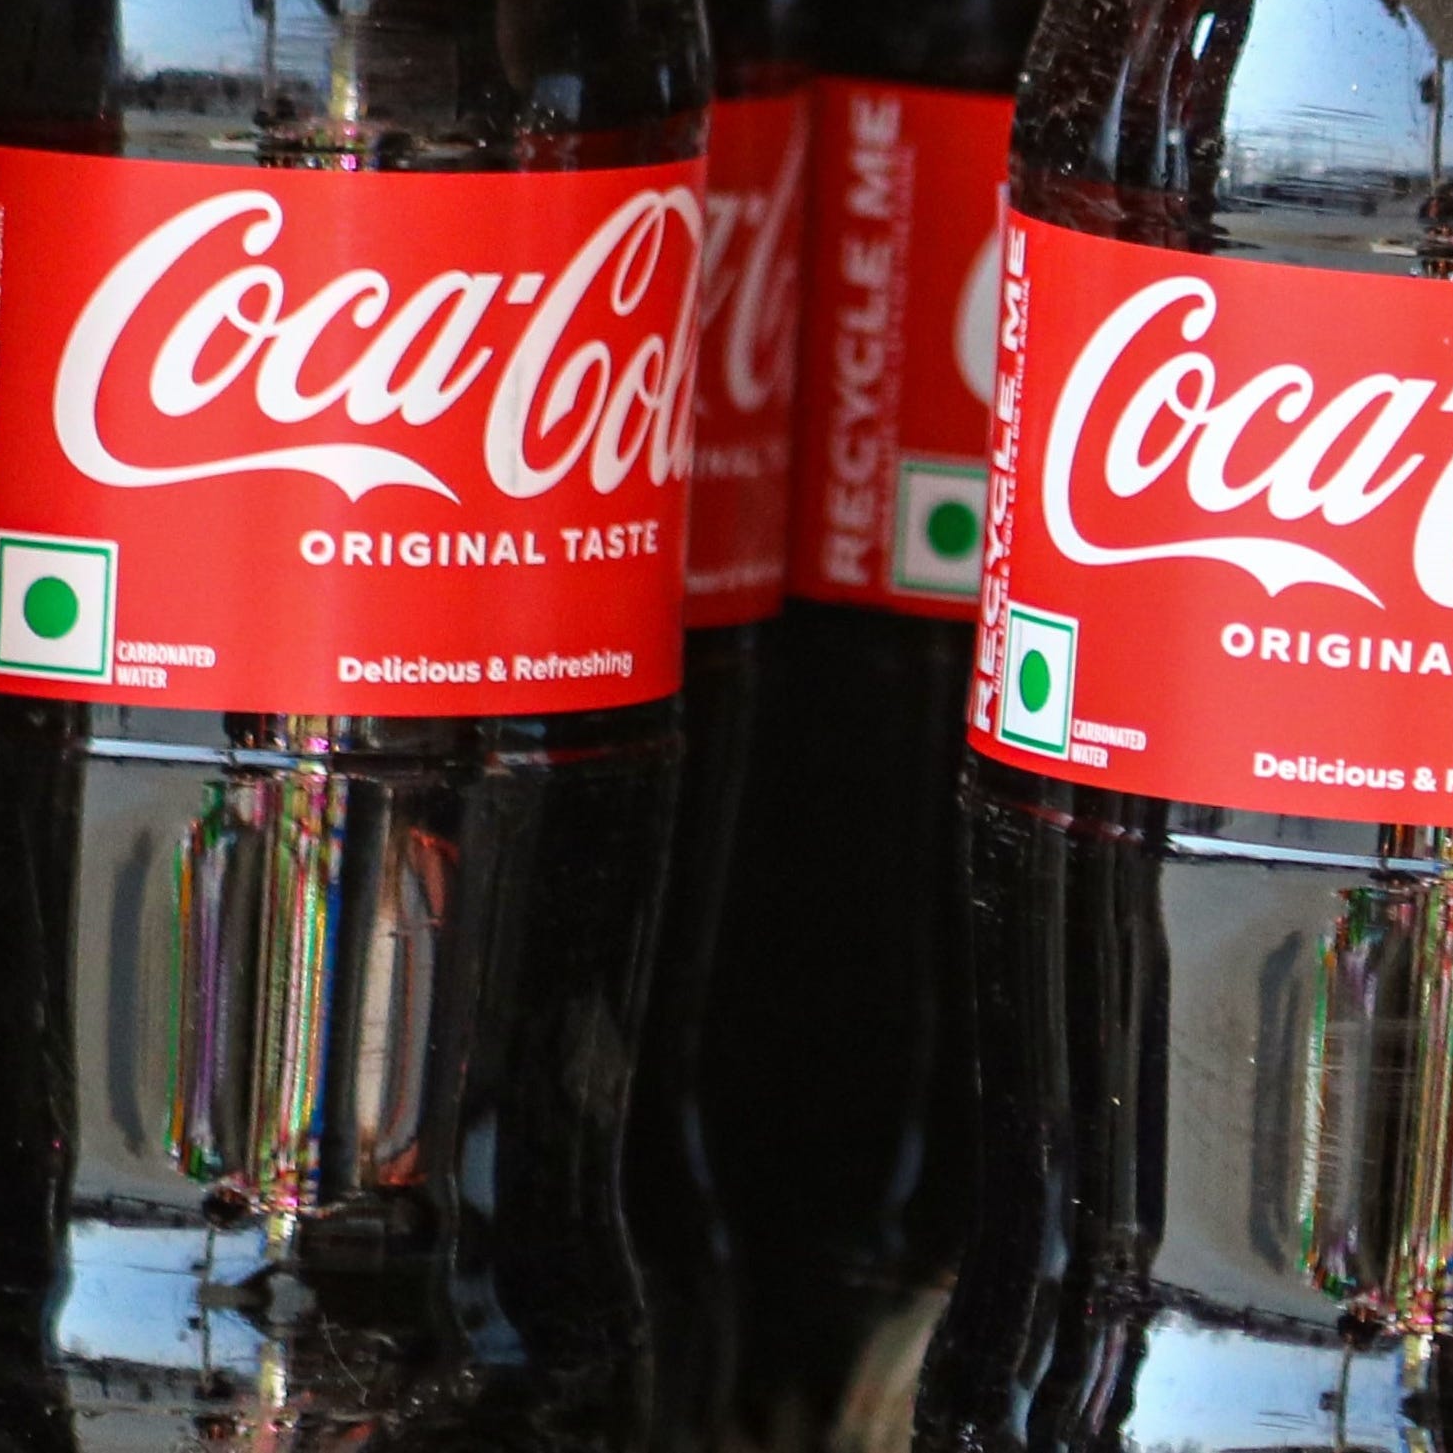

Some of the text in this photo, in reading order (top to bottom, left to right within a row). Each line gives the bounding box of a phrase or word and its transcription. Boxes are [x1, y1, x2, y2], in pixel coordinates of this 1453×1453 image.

[824, 100, 900, 585] RECYCLE ME
[973, 374, 1015, 733] RECYCLE
[1003, 228, 1027, 352] ME
[300, 521, 658, 566] ORIGINAL TASTE
[116, 640, 216, 668] CARBONATED
[338, 651, 632, 682] Delicious & Refreshing
[116, 665, 168, 689] WATER
[1072, 719, 1147, 751] CARBONATED
[1071, 743, 1108, 768] WATER
[1254, 752, 1404, 789] Delicious
[1413, 767, 1436, 791] &
